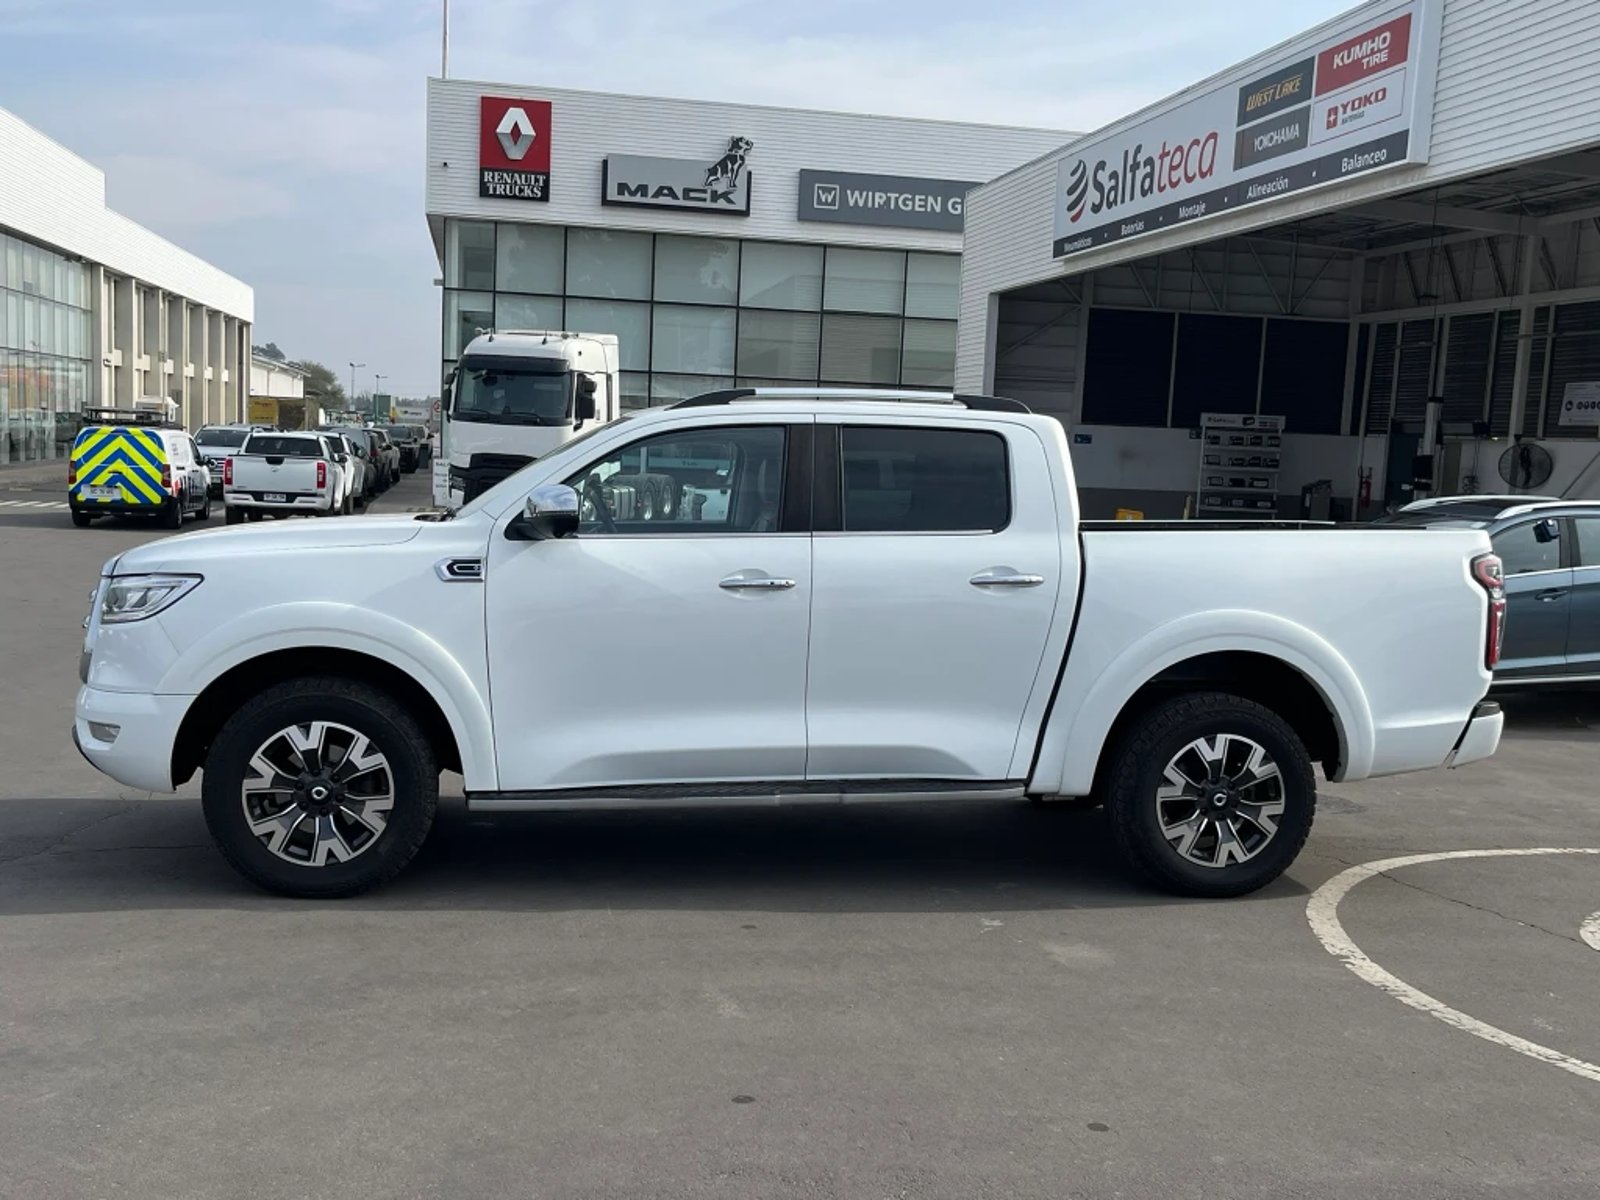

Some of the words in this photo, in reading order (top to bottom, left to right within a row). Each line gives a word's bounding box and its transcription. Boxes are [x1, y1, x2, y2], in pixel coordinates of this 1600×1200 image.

[1333, 31, 1391, 69] KUMHO
[1361, 49, 1389, 70] TIRE
[1246, 87, 1276, 112] WEST
[1275, 75, 1303, 100] LAKE
[1341, 87, 1387, 114] YOKO
[1254, 122, 1300, 152] YOKOHAMA
[484, 171, 546, 187] RENAULT
[1090, 131, 1218, 214] Salfateca
[1178, 200, 1206, 219] Montaje
[1246, 175, 1289, 199] Alineación
[1341, 148, 1387, 173] Balanceo
[487, 183, 542, 198] TRUCKS
[617, 182, 736, 205] MACK
[846, 189, 942, 213] WIRTGEN
[947, 197, 962, 215] G
